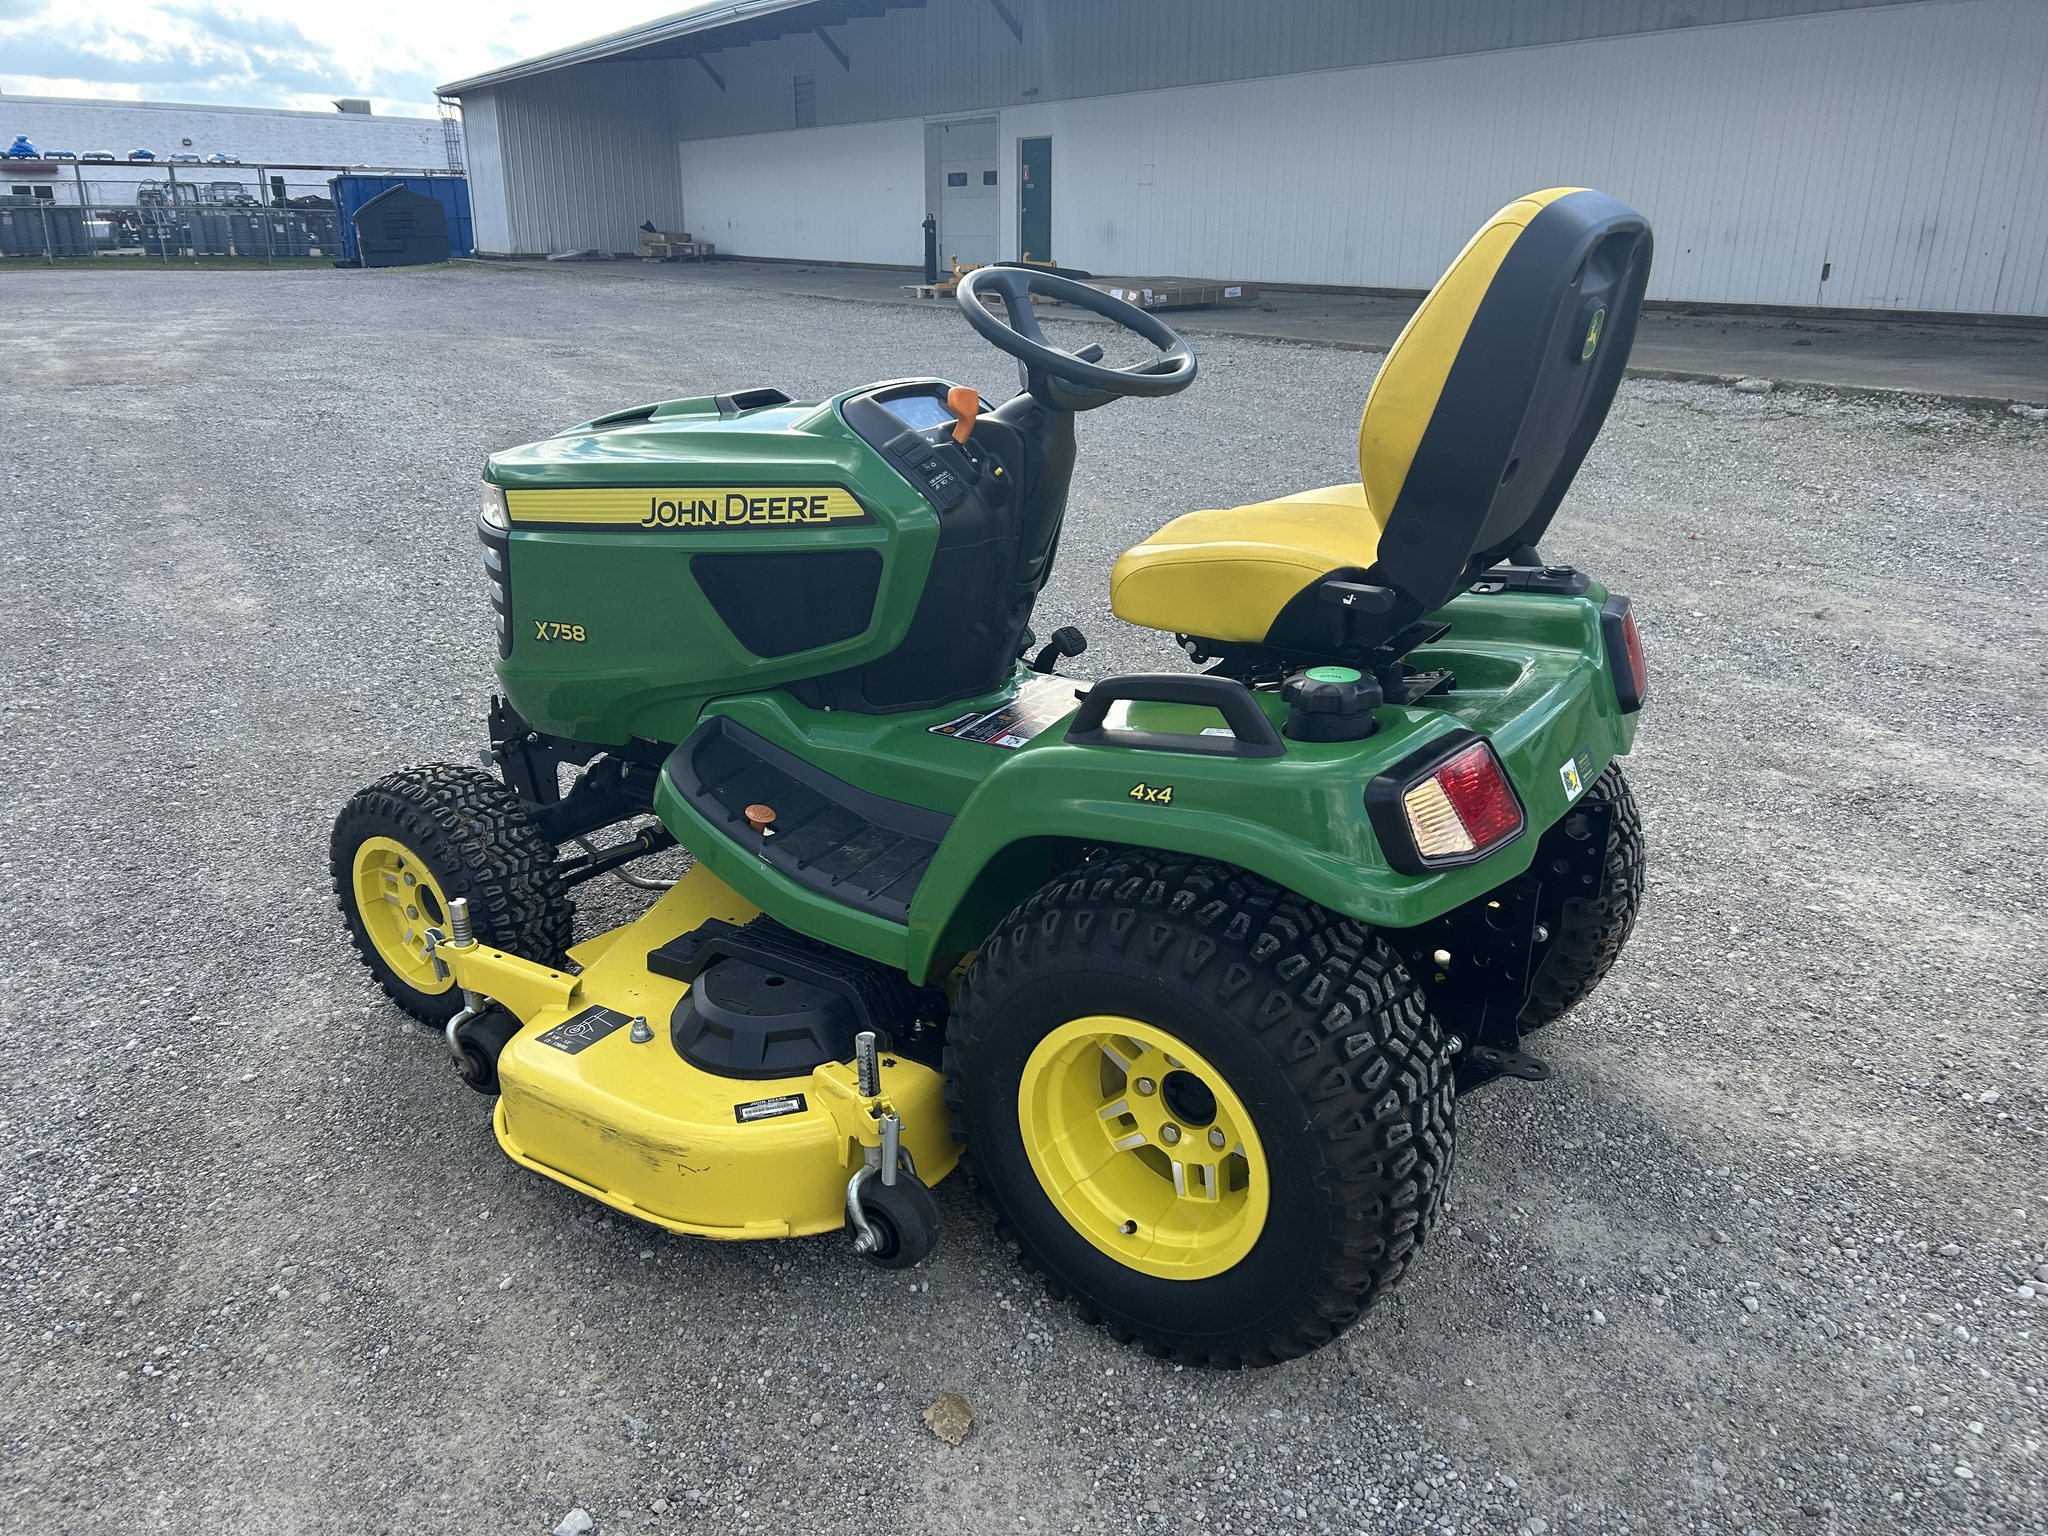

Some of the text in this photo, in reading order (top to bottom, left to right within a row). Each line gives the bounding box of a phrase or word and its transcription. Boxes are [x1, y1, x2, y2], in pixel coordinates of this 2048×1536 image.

[641, 493, 831, 527] JOHN DEERE
[533, 619, 587, 643] X758
[1129, 783, 1173, 804] 4x4
